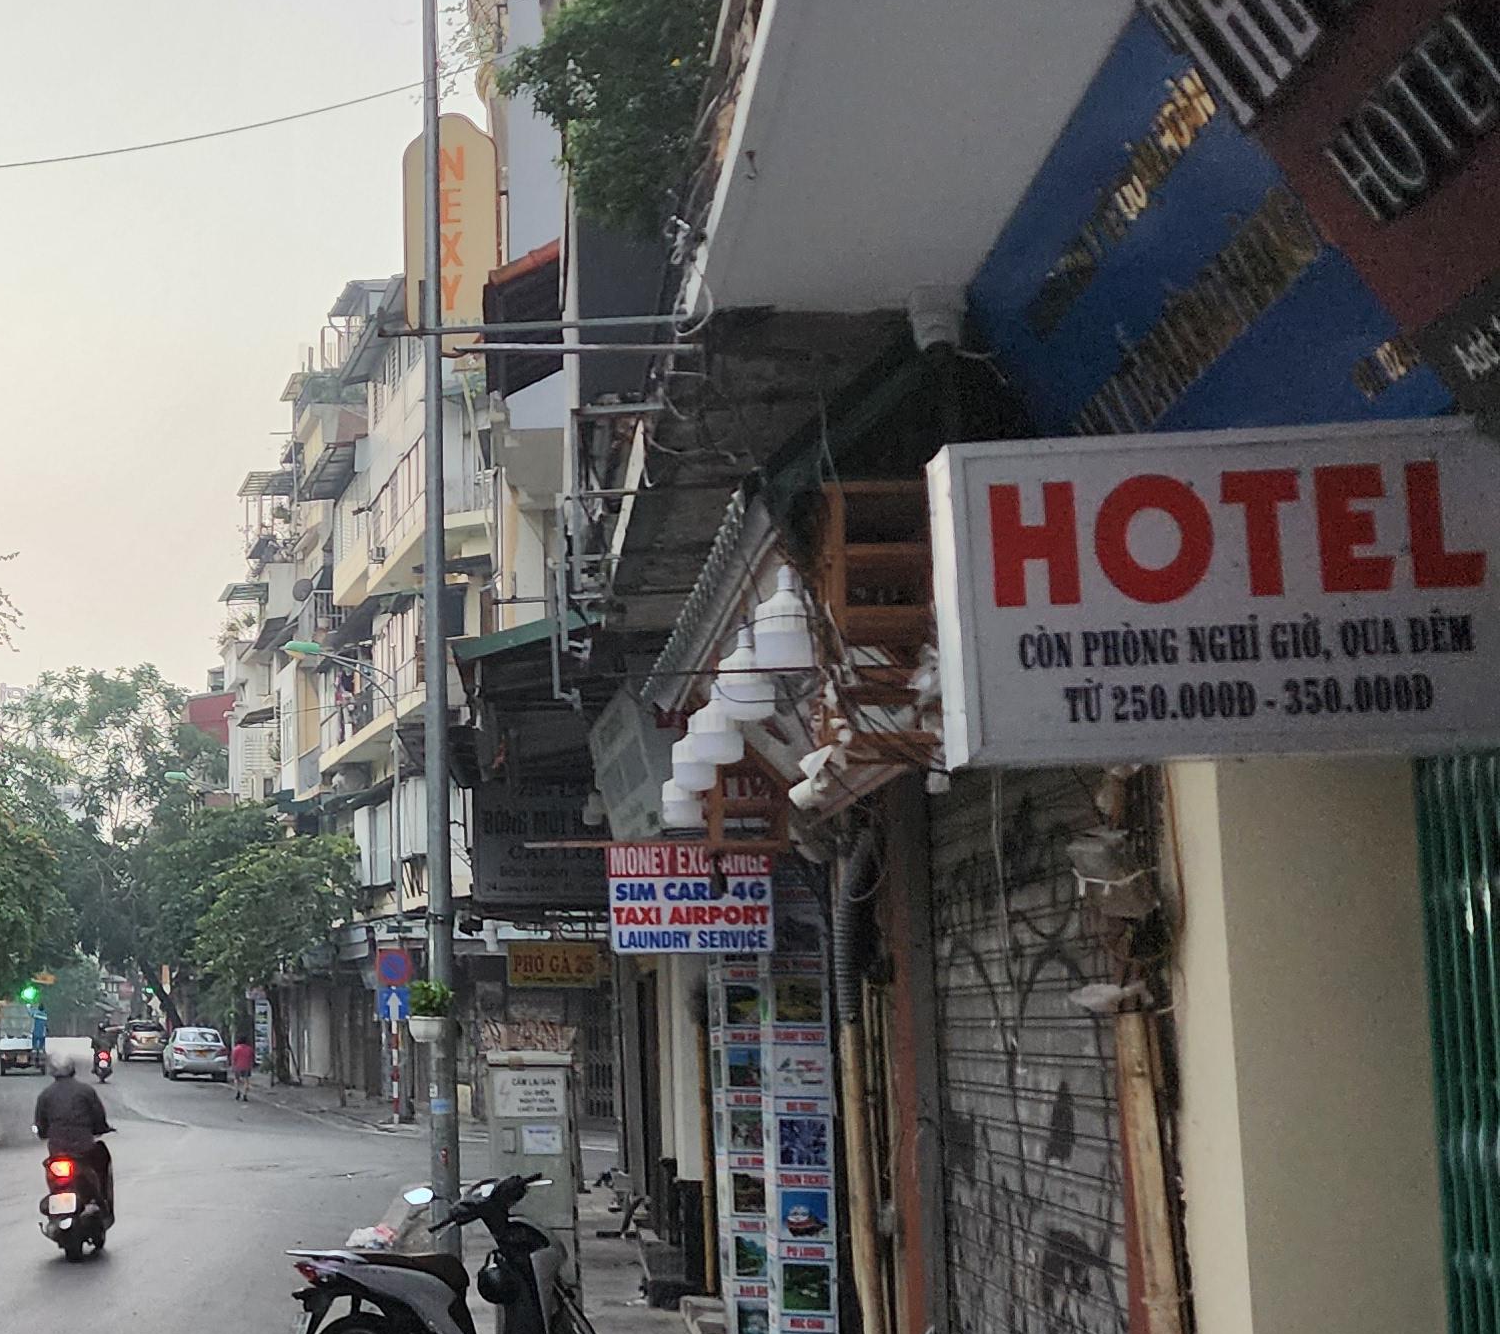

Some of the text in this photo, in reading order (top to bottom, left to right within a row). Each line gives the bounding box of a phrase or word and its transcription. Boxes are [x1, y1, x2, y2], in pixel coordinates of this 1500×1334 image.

[438, 144, 464, 312] NEXY
[987, 459, 1488, 609] HOTEL
[1018, 625, 1072, 670] CÒN
[1081, 621, 1179, 668] PHÒNG
[1186, 613, 1262, 663] NGHỈ
[1339, 618, 1400, 658] QUA
[1064, 678, 1103, 724] TỪ
[609, 846, 671, 876] MONEY
[676, 846, 769, 875] EXCANGE
[615, 882, 657, 901] SIM
[732, 881, 767, 901] 4G
[613, 906, 770, 926] TAXI AIRPORT
[618, 929, 768, 949] LAUNDRY SERVICE
